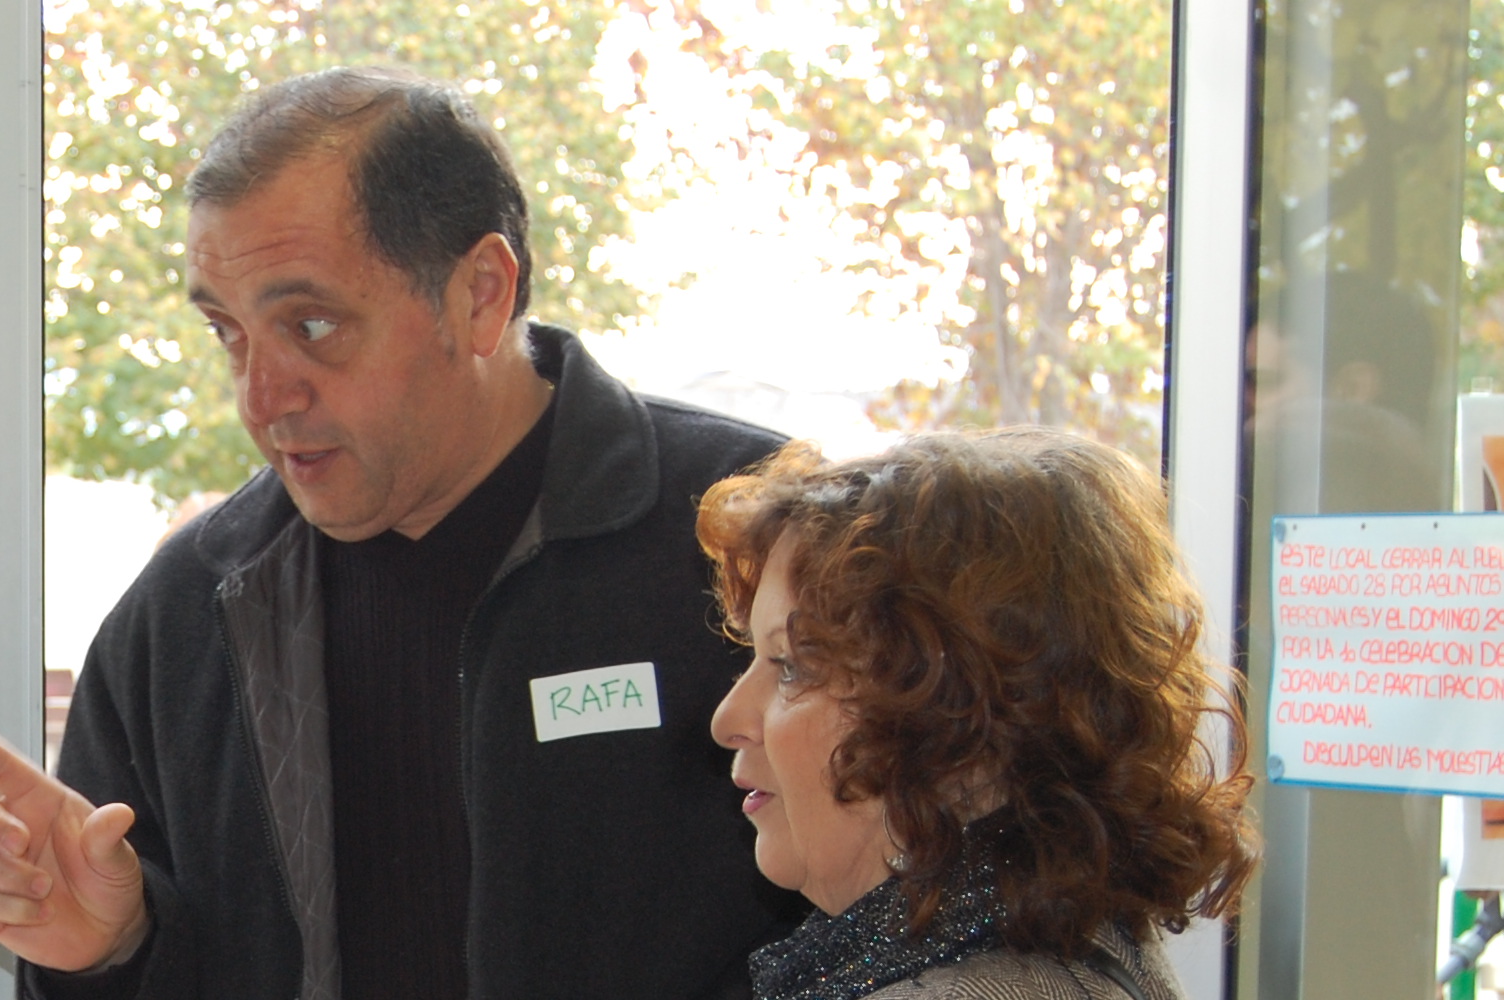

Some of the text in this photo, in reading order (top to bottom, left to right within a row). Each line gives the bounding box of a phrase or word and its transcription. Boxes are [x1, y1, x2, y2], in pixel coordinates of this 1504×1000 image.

[1330, 547, 1377, 570] LOCAL
[1447, 547, 1470, 568] AL
[1300, 573, 1360, 595] SABADO
[1364, 573, 1386, 597] 28
[1392, 573, 1422, 596] POR
[1425, 573, 1501, 597] ASUNTOS
[1371, 607, 1383, 627] Y
[1410, 606, 1480, 631] DOMINGO
[1282, 636, 1311, 659] POR
[1317, 638, 1333, 659] LA
[1280, 668, 1350, 692] JORNADA
[1383, 672, 1504, 700] PARTICIPACION
[550, 679, 643, 720] RAFA
[1397, 746, 1422, 769] LAS
